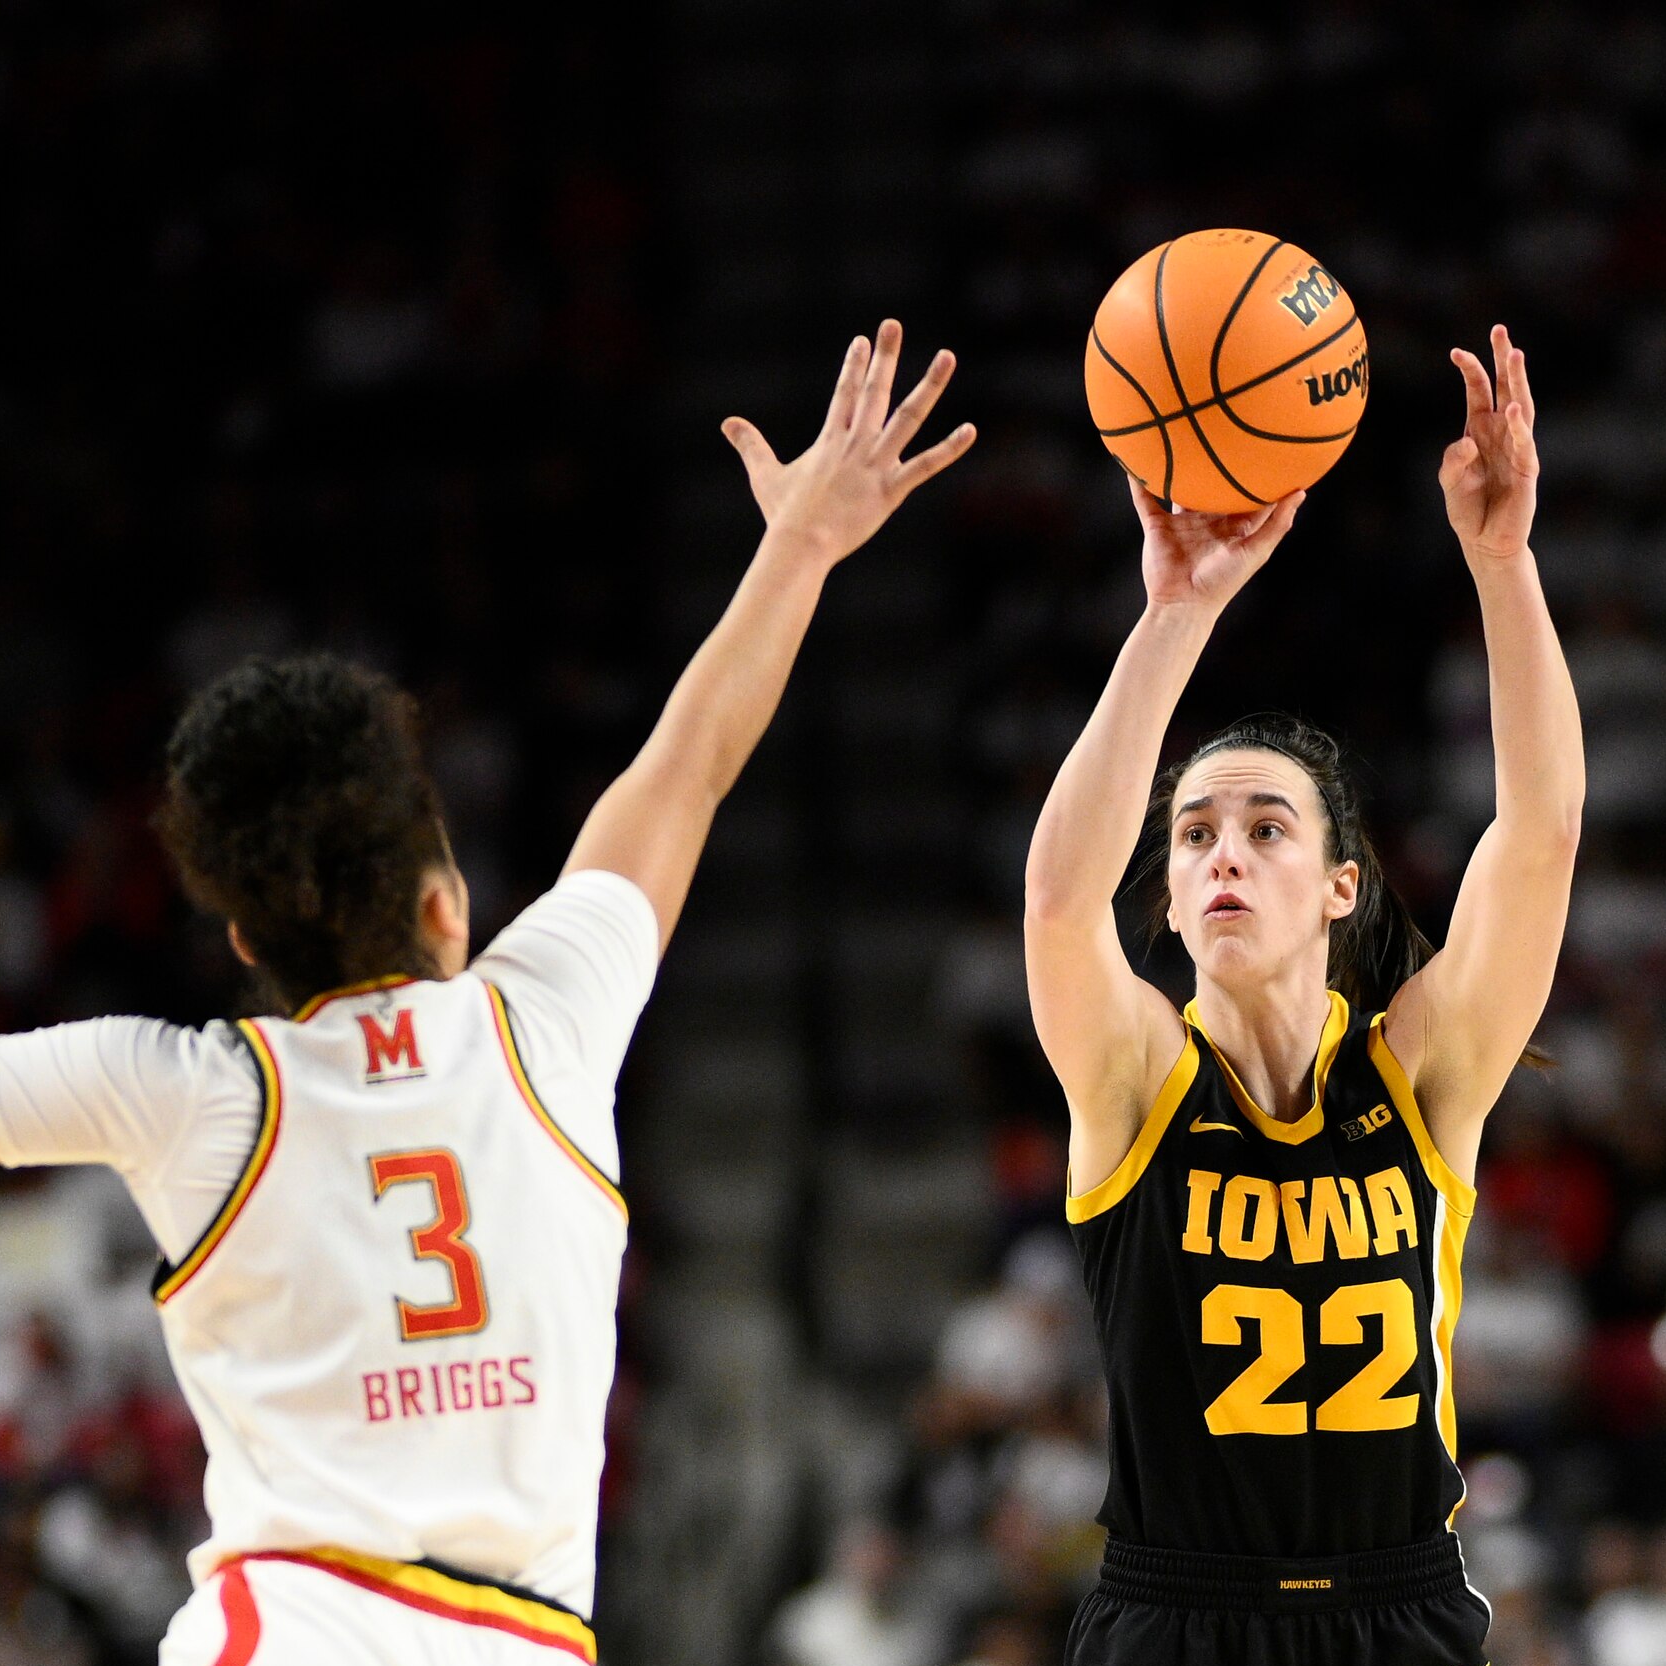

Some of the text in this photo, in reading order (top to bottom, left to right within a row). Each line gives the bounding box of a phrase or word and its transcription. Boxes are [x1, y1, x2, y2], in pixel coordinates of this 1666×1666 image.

[1278, 263, 1343, 328] CAA
[1304, 353, 1369, 406] lson
[355, 1008, 426, 1076] M
[367, 1146, 491, 1343] 3
[1181, 1167, 1418, 1265] IOWA
[1201, 1277, 1420, 1436] 22
[361, 1357, 537, 1424] BRIGGS
[1279, 1579, 1332, 1590] HAWKEYES
